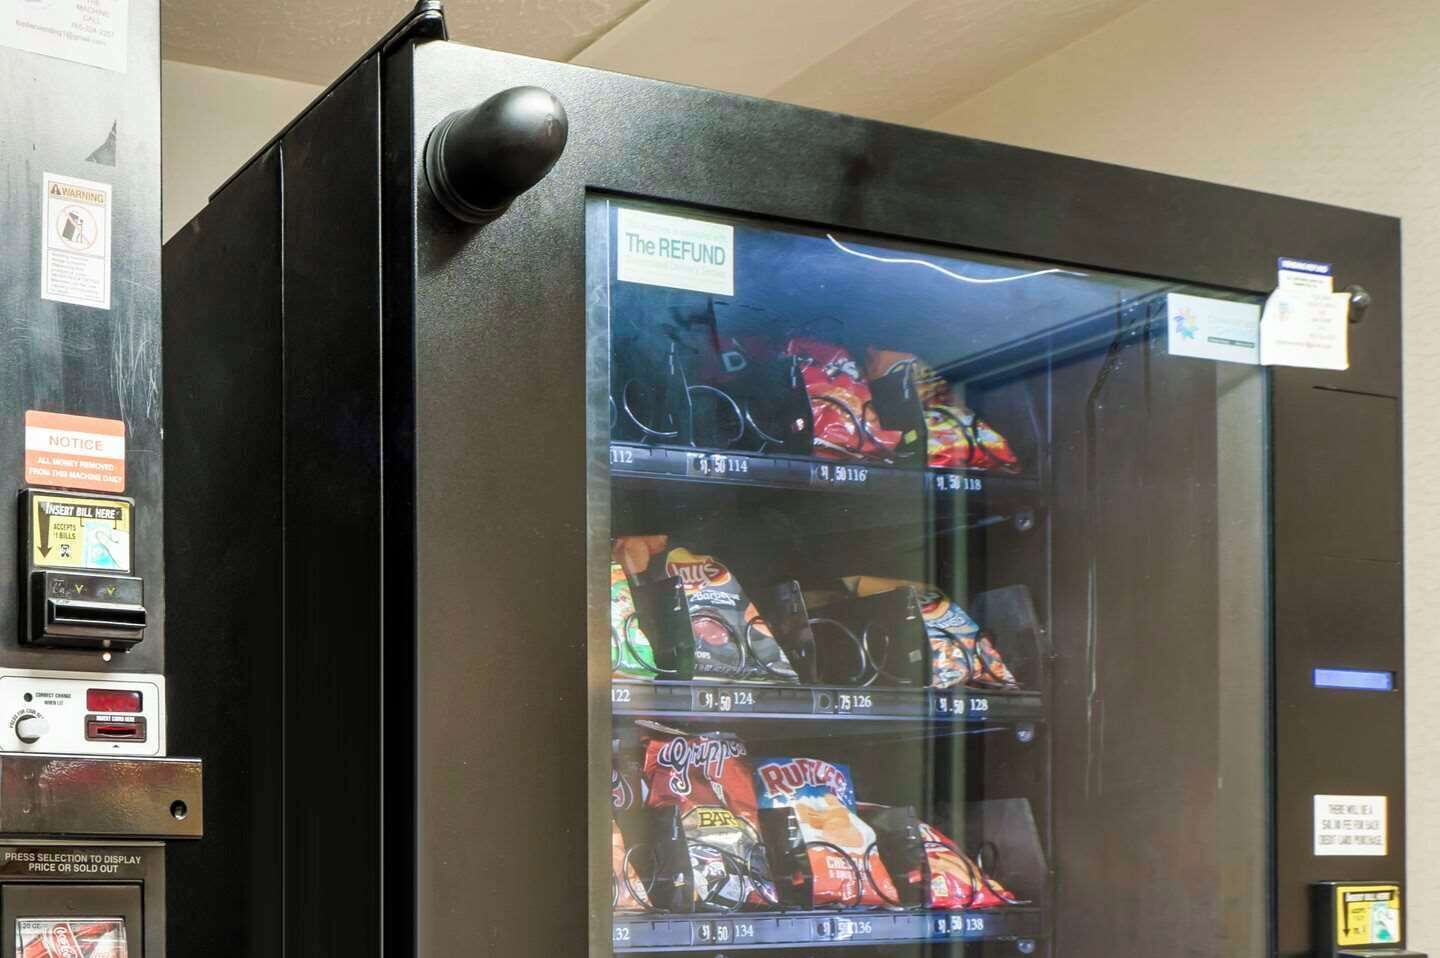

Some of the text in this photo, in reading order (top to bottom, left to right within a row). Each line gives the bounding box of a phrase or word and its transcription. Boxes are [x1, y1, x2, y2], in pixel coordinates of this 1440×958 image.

[62, 187, 104, 203] WARNING
[625, 232, 726, 266] The REFUND
[49, 436, 103, 451] NOTICE
[613, 450, 633, 463] 112
[729, 459, 748, 472] 114
[847, 468, 867, 481] 116
[964, 478, 981, 490] 118
[45, 502, 116, 519] INSERT BILL HERE
[53, 523, 76, 531] ACCEPTS
[611, 689, 631, 702] 122
[734, 692, 753, 705] 124
[853, 695, 872, 709] 126
[970, 699, 988, 711] 128
[5, 852, 141, 864] PRESS SELECTION TO DISPLAY
[28, 863, 119, 873] PRICE OR SOLD OUT
[735, 925, 753, 937] 134
[853, 921, 872, 934] 136
[966, 918, 984, 931] 138
[613, 928, 630, 940] 32
